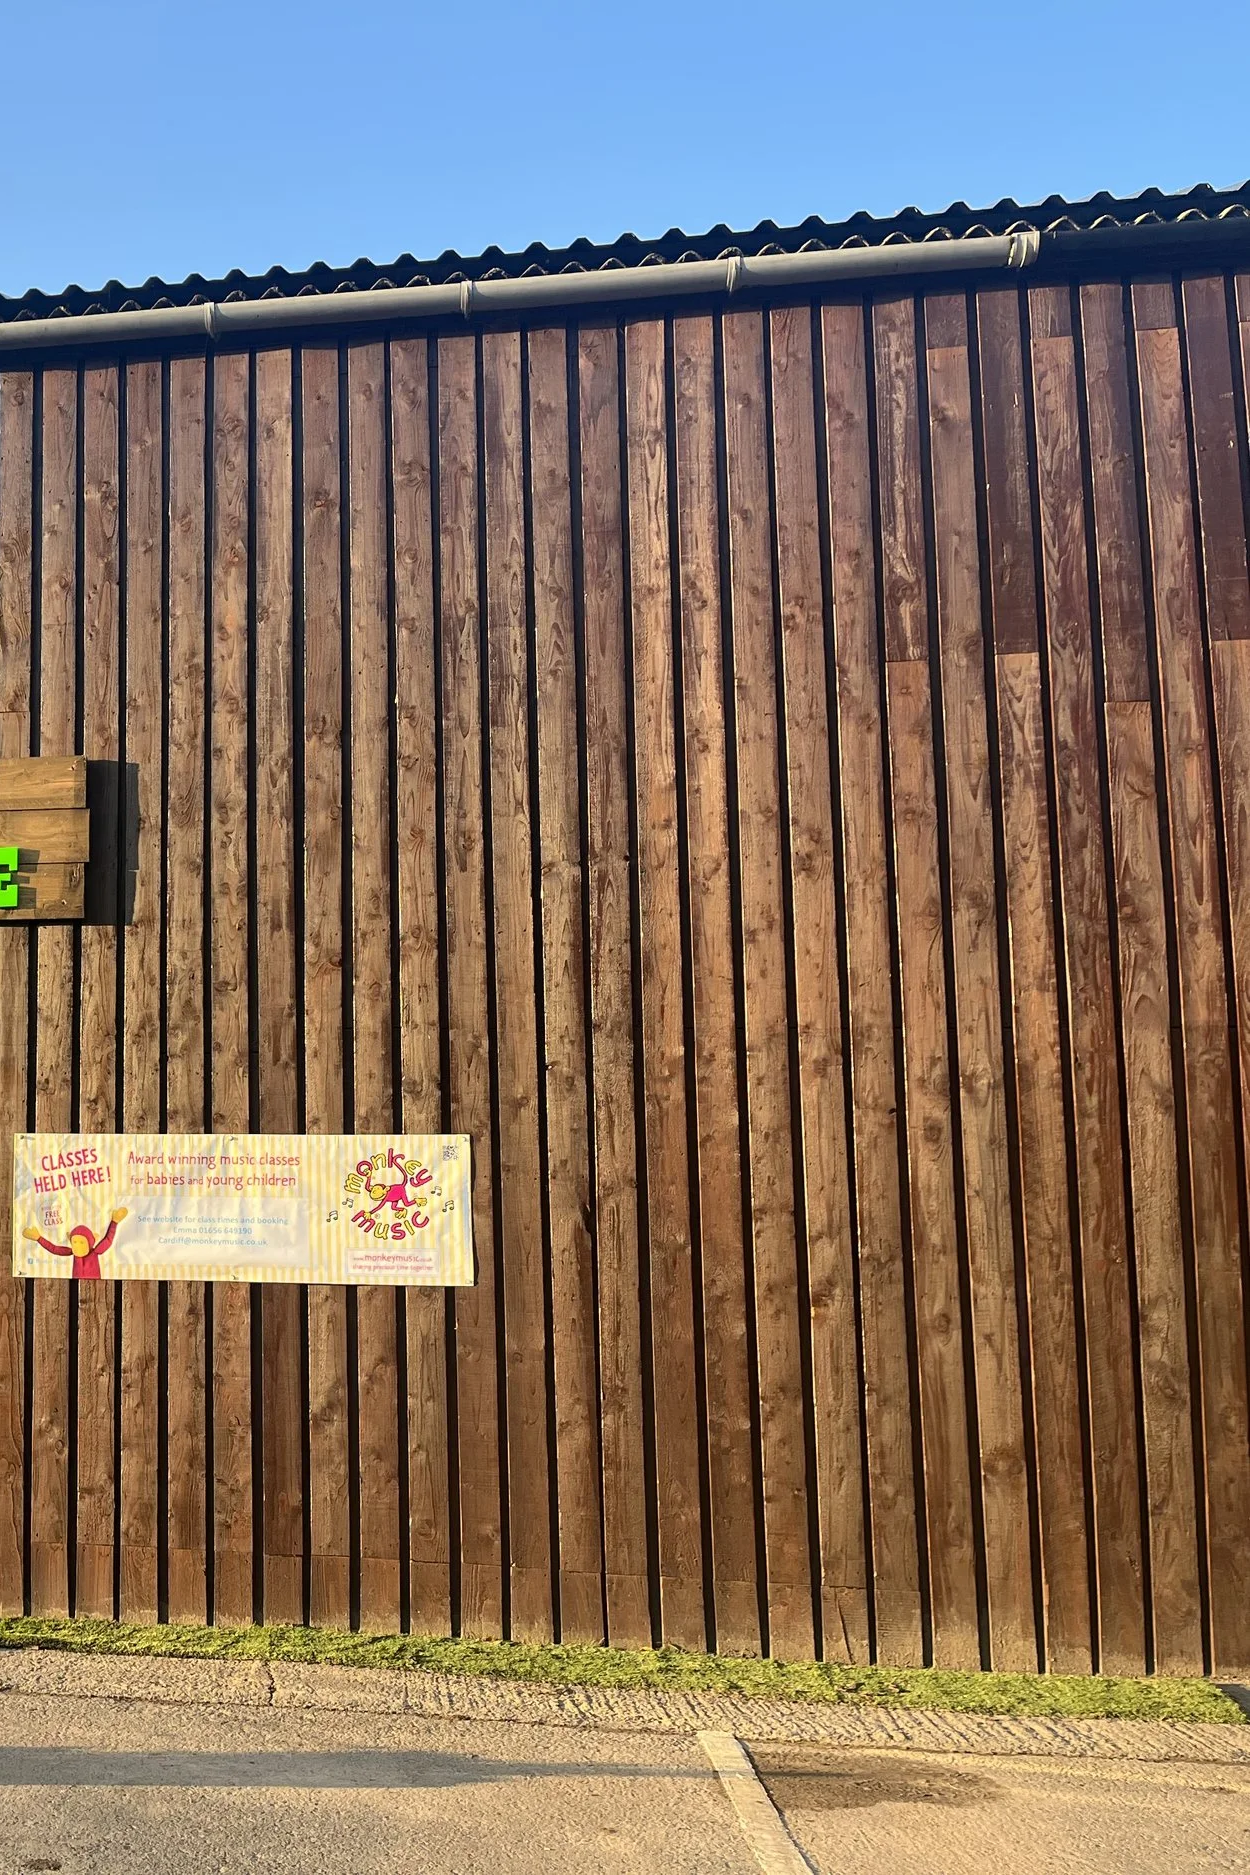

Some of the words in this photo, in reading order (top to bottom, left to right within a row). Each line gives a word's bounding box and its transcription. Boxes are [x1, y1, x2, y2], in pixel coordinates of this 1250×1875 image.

[41, 1148, 98, 1172] CLASSES
[127, 1151, 164, 1165] Award
[168, 1153, 216, 1169] winning
[220, 1154, 255, 1165] music
[259, 1153, 300, 1166] classes
[344, 1148, 433, 1194] monkey
[34, 1174, 67, 1194] HELD
[130, 1177, 144, 1185] for
[147, 1172, 185, 1185] babies
[187, 1177, 204, 1185] and
[206, 1177, 243, 1191] young
[246, 1174, 296, 1187] children
[44, 1217, 64, 1226] CLASS
[197, 1216, 215, 1224] class
[217, 1216, 239, 1224] times
[257, 1217, 288, 1226] booking
[351, 1210, 430, 1240] music
